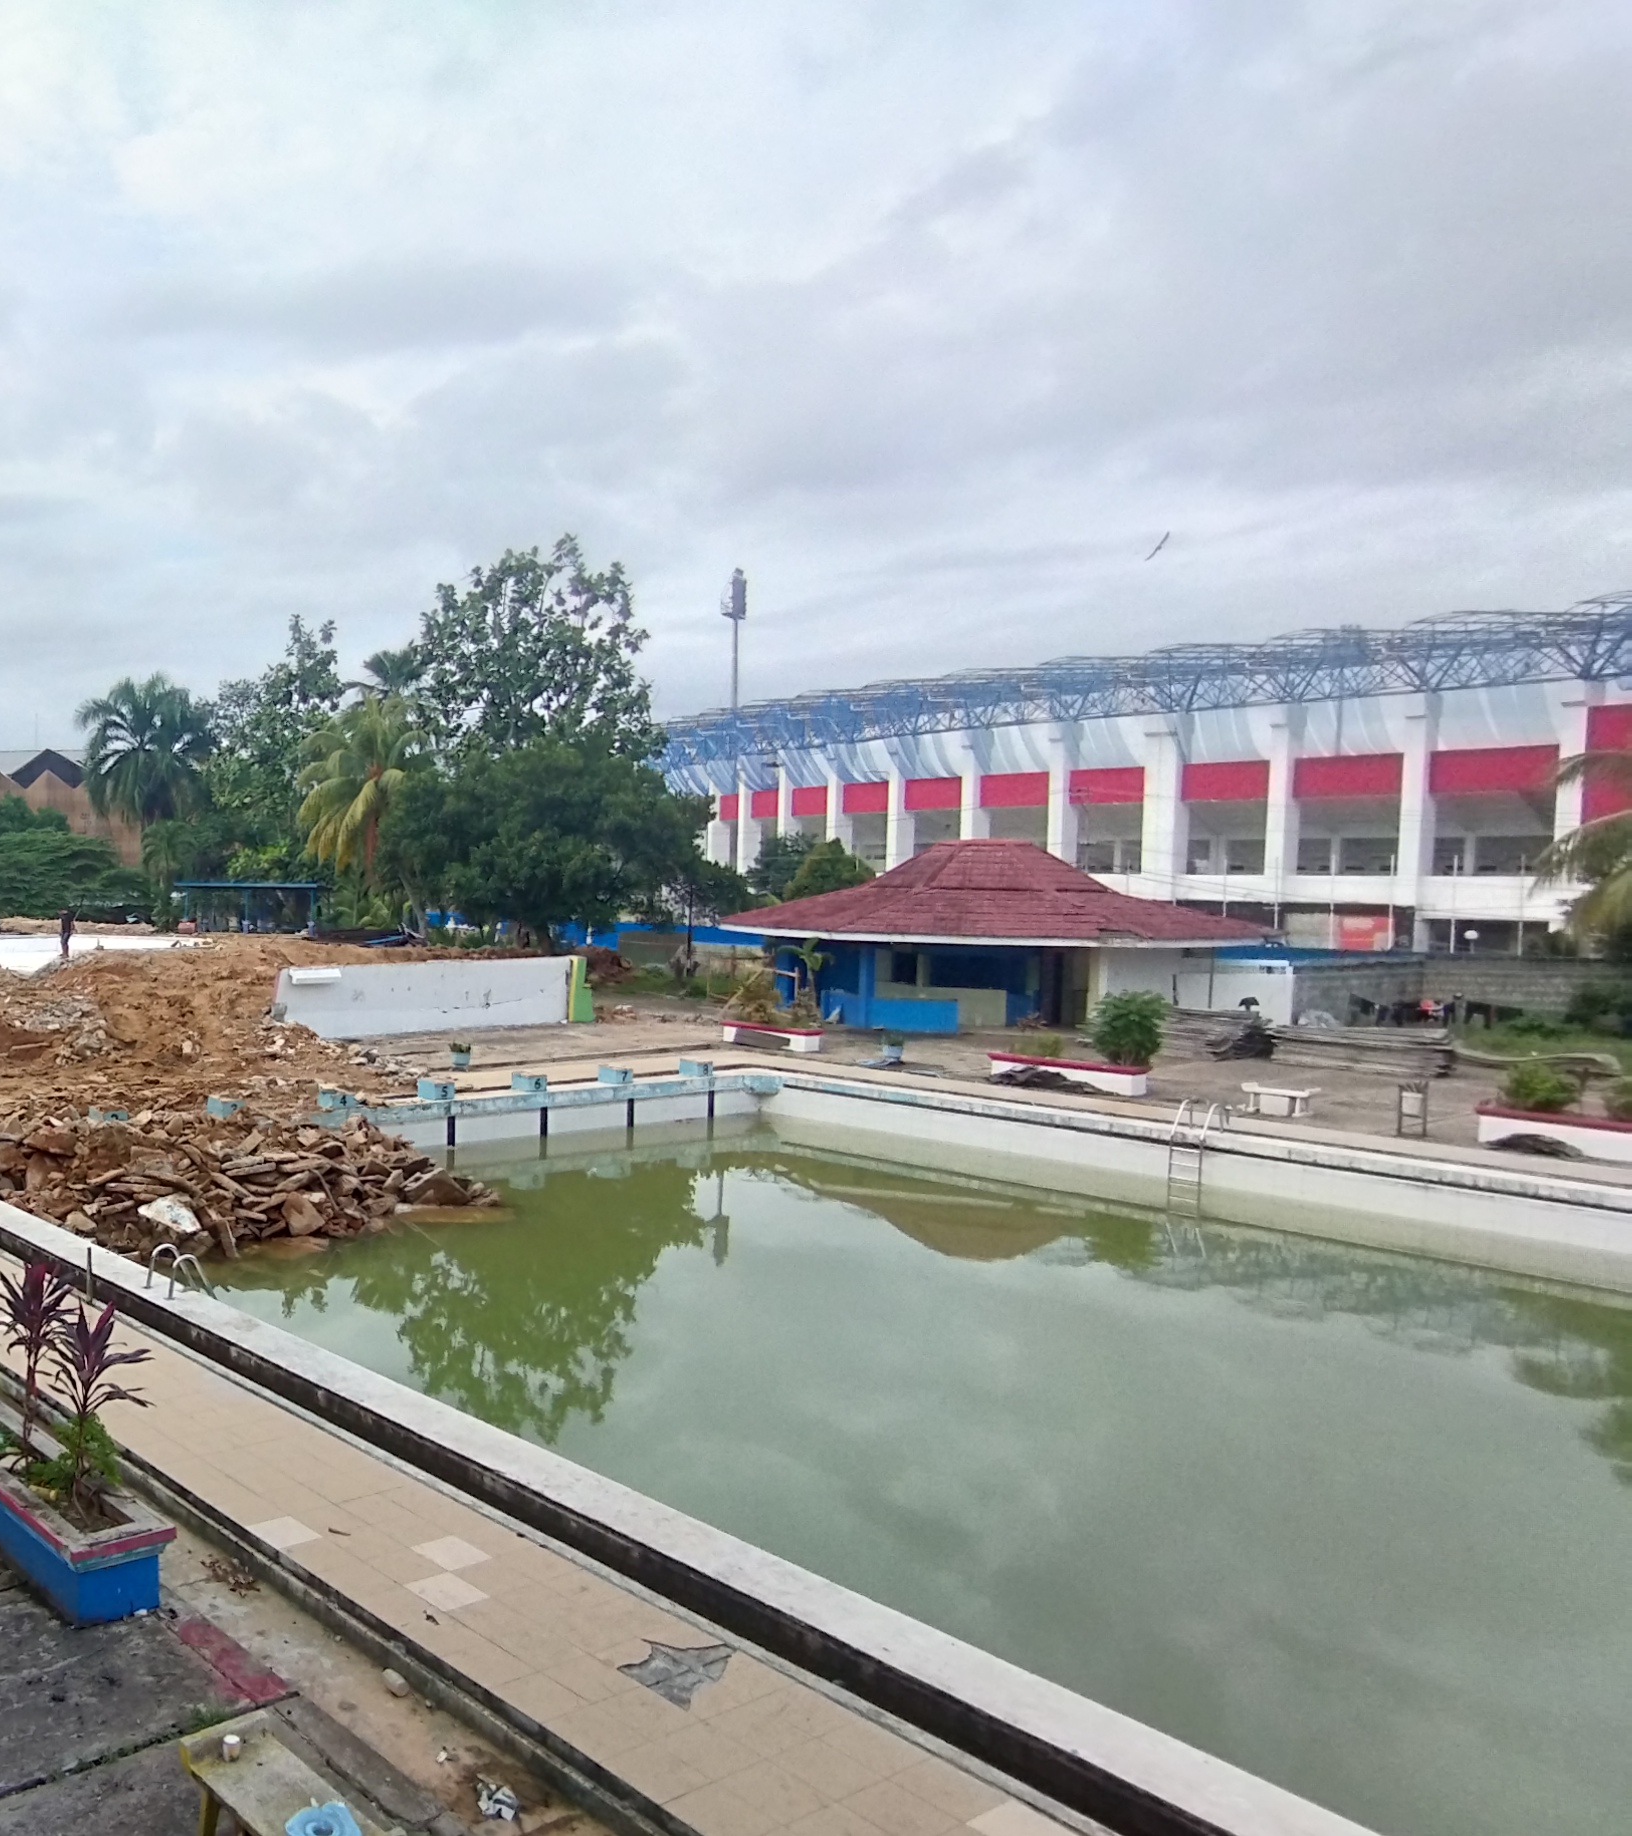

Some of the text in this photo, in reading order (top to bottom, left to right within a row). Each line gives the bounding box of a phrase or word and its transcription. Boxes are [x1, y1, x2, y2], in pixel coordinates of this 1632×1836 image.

[702, 1063, 709, 1075] 8
[621, 1070, 628, 1082] 7
[534, 1077, 541, 1090] 6
[441, 1085, 448, 1098] 5
[339, 1094, 348, 1106] 4
